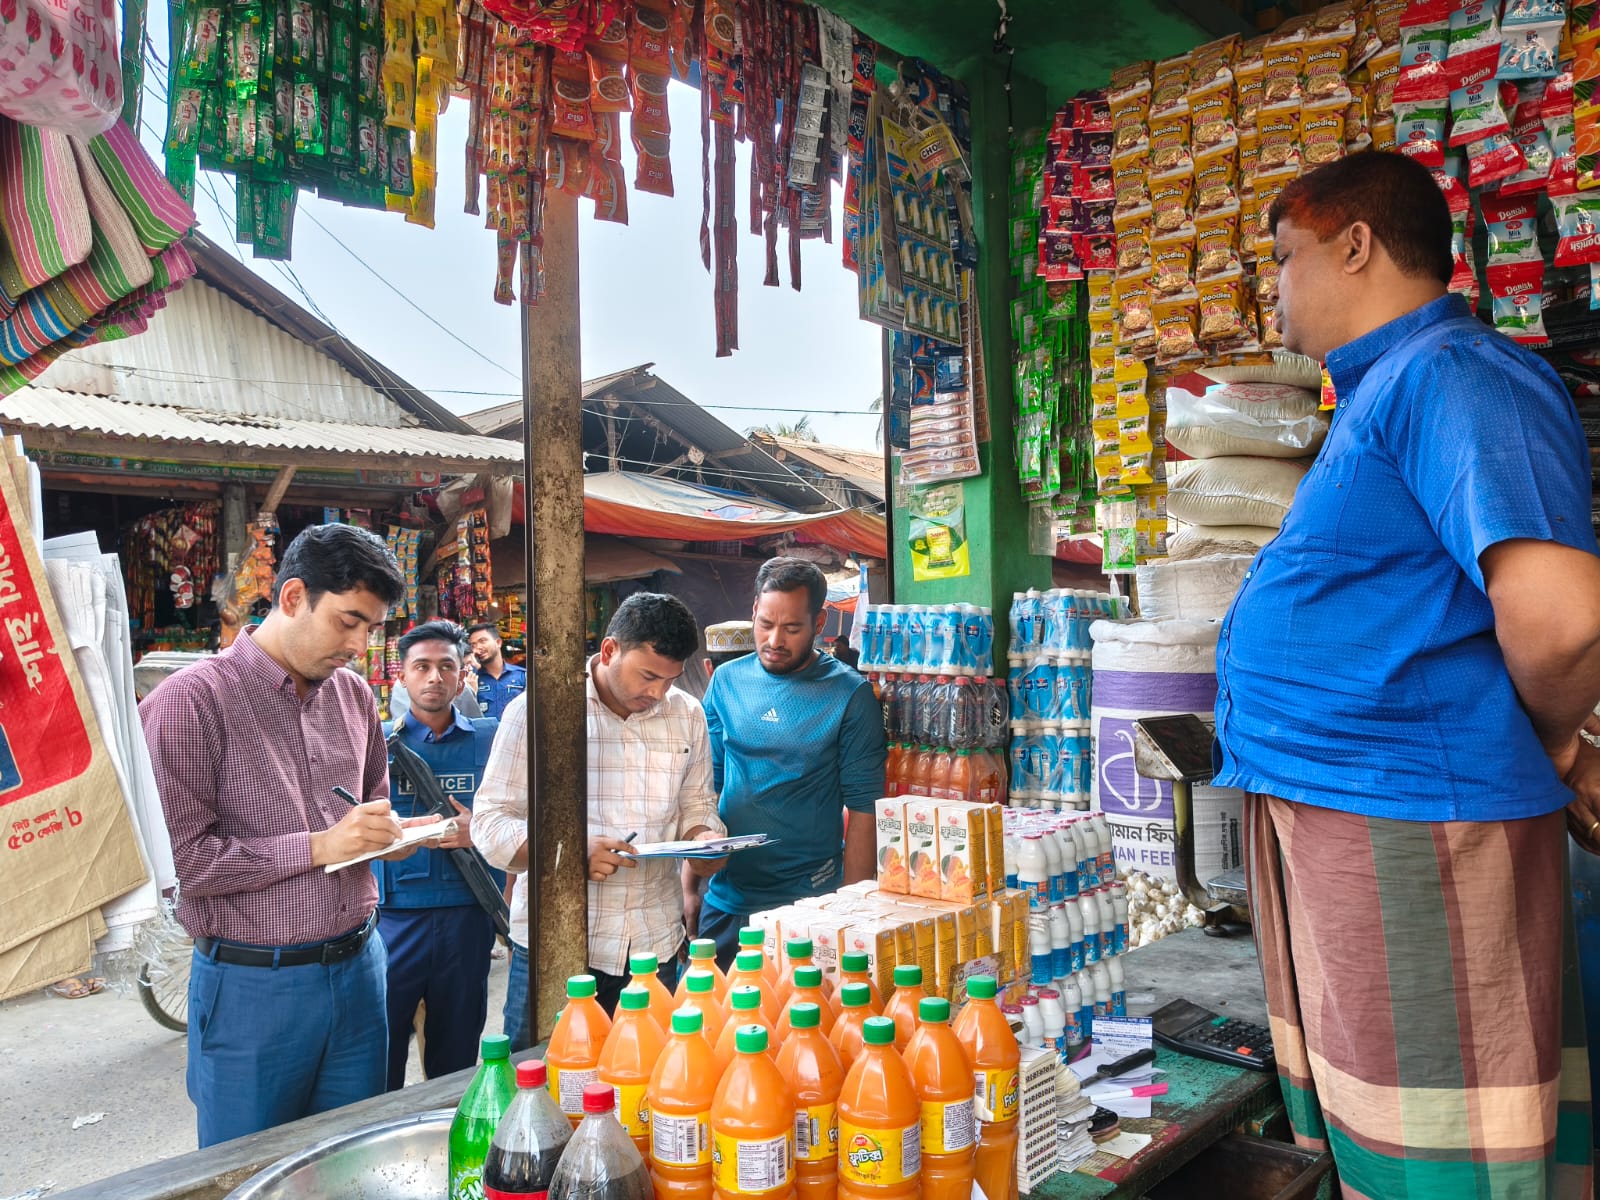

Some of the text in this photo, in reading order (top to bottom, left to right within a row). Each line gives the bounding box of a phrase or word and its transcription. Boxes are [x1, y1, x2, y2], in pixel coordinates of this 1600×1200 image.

[1467, 14, 1481, 23] Milk
[1267, 56, 1299, 67] Noodles
[1307, 51, 1341, 63] Noodles
[1307, 66, 1338, 76] Masala
[1374, 66, 1400, 80] Noodl
[1460, 67, 1491, 86] Danish
[1241, 82, 1262, 93] Nood
[1468, 94, 1482, 103] Milk
[1193, 100, 1223, 113] Noodles
[1262, 124, 1293, 133] Noodles
[1305, 120, 1338, 131] Noodles
[1411, 122, 1425, 131] Milk
[1153, 126, 1182, 137] Noodles
[1305, 134, 1336, 145] Masala
[1116, 168, 1143, 178] Noodles
[1198, 166, 1226, 178] Noodles
[1155, 189, 1183, 200] Noodles
[1497, 206, 1528, 220] Danish
[1117, 228, 1143, 239] Noodles
[1200, 228, 1229, 240] Noodles
[1508, 229, 1523, 238] Milk
[1156, 253, 1186, 262] Noodles
[1504, 281, 1533, 295] Danish
[1120, 289, 1148, 300] Noodles
[1202, 293, 1232, 303] Noodles
[1159, 315, 1190, 326] Noodles
[406, 777, 467, 792] PICE
[8, 831, 35, 850] ৫০
